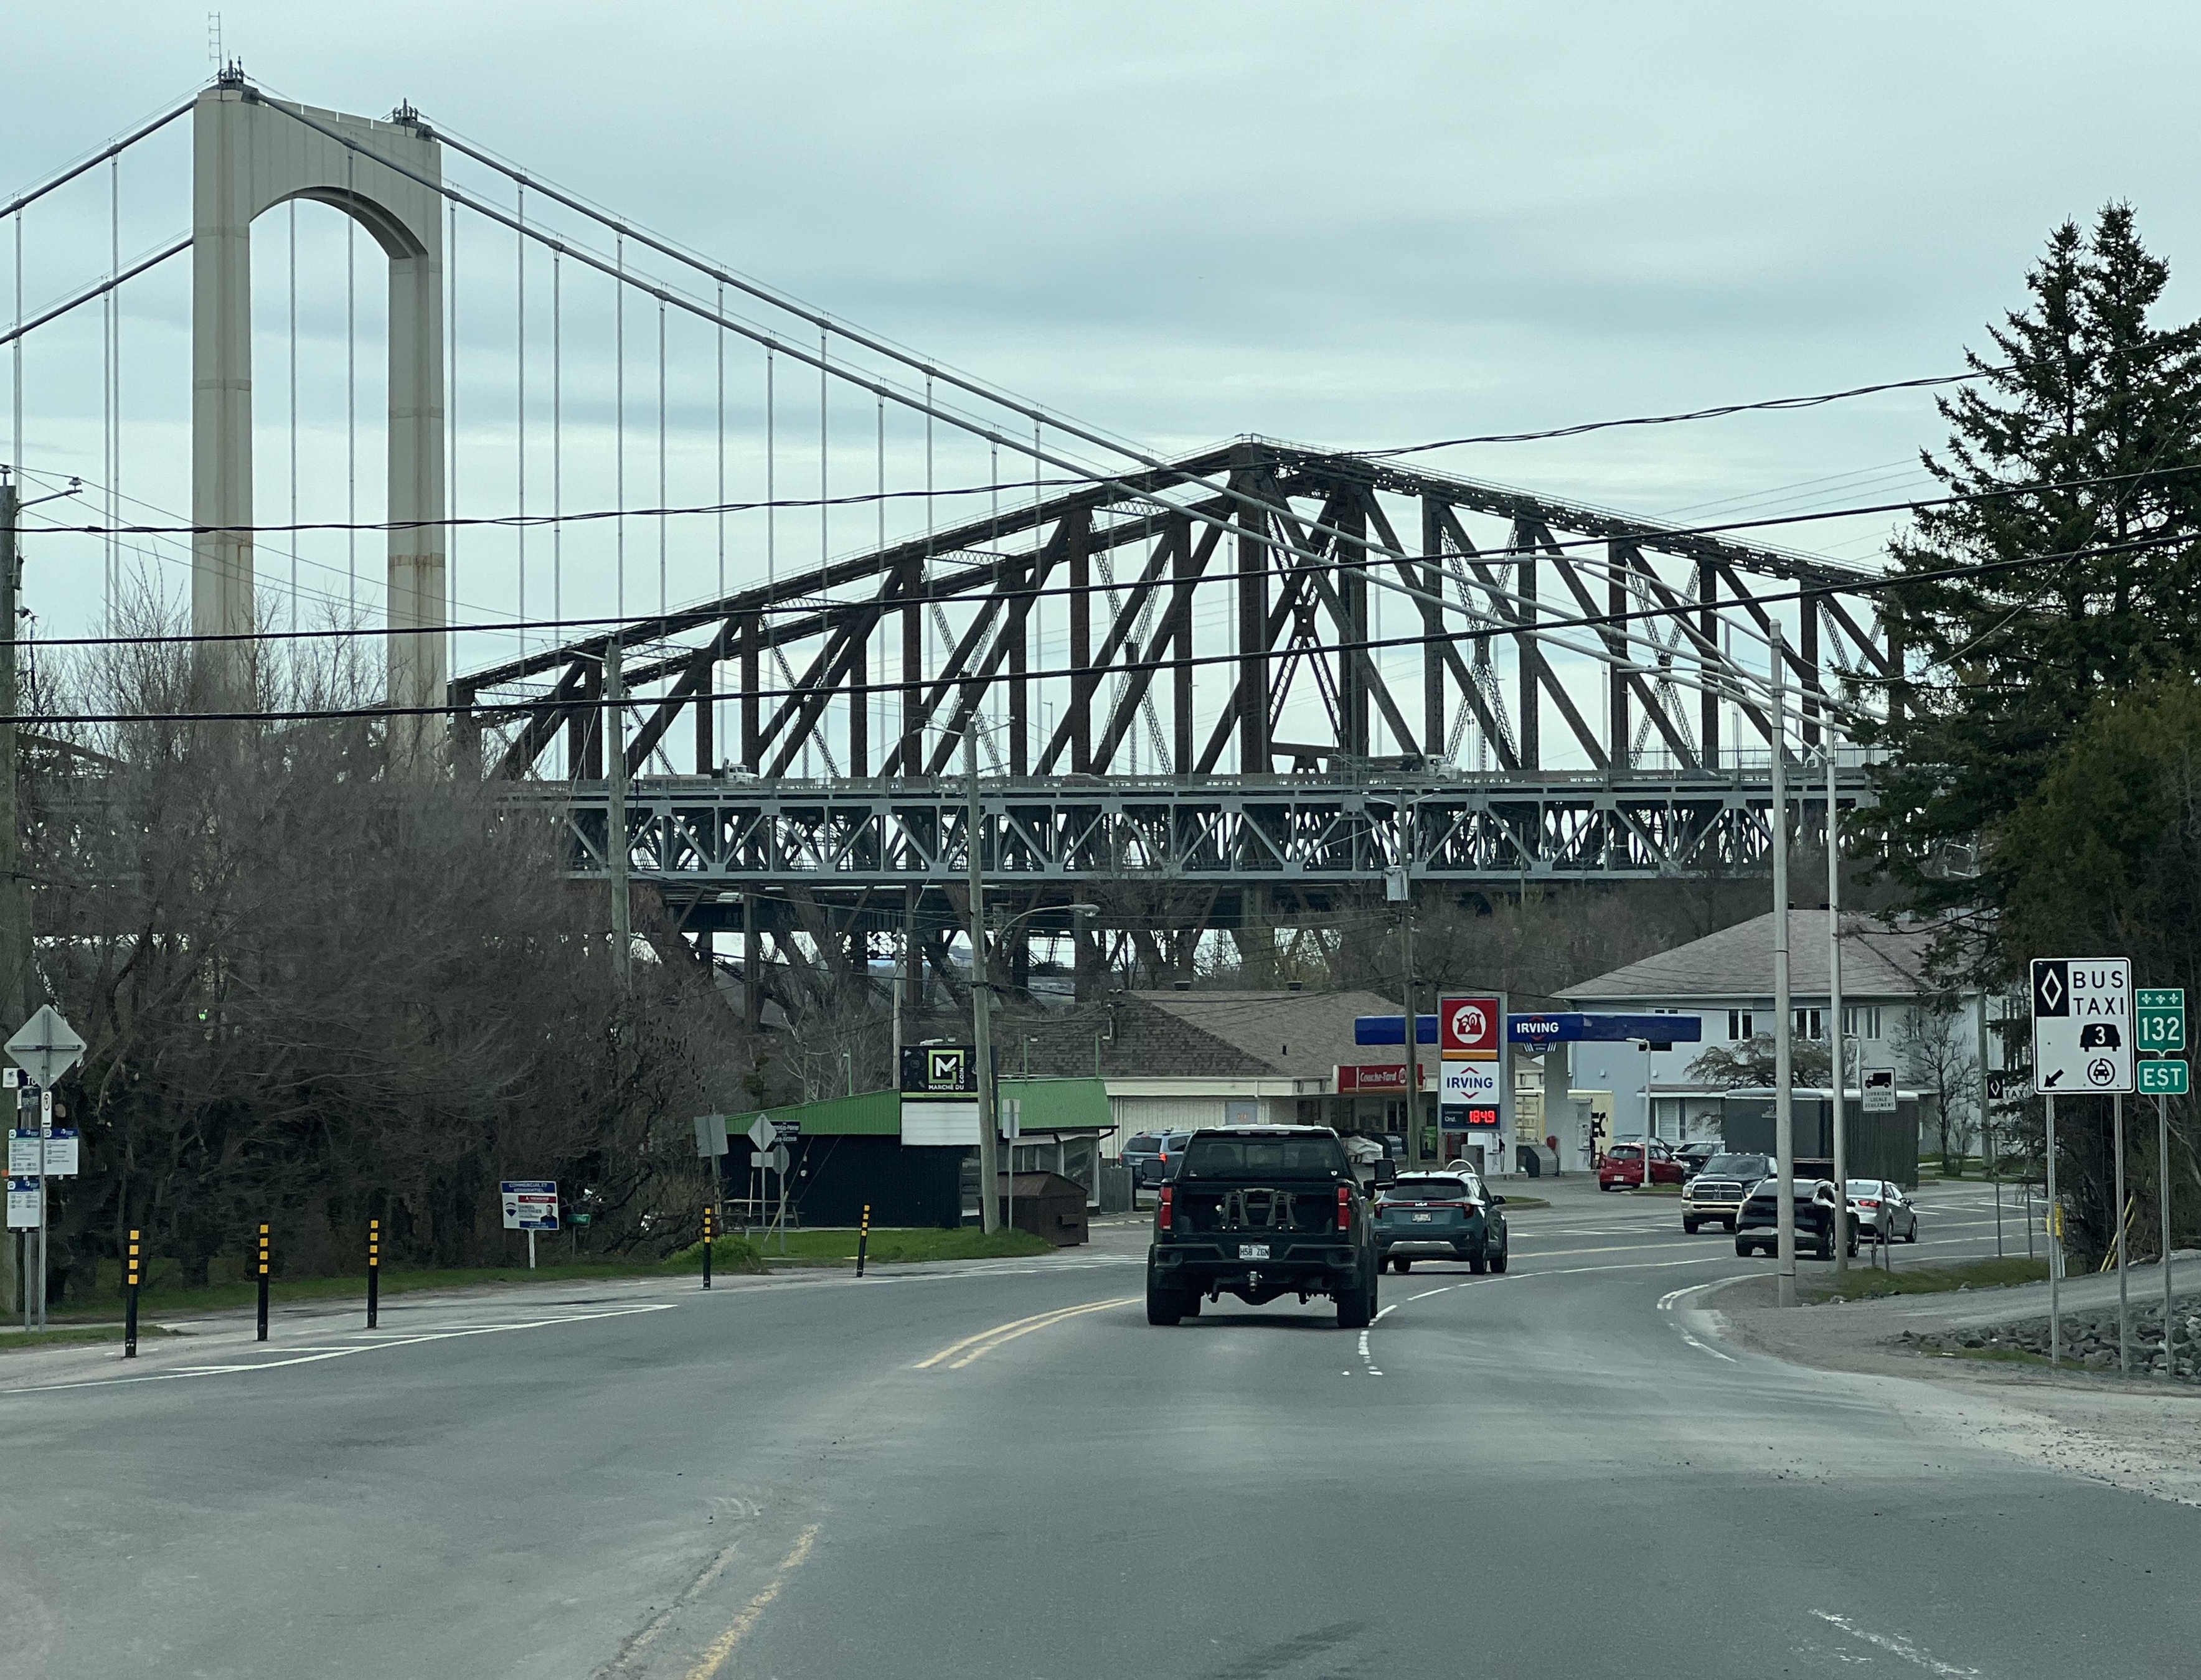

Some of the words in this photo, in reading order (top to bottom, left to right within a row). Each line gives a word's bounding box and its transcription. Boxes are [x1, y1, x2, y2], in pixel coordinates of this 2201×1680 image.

[2073, 970, 2124, 988] BUS
[2073, 997, 2124, 1016] TAXI
[1516, 1022, 1560, 1033] IRVING
[2095, 1026, 2106, 1045] 3
[2142, 1016, 2180, 1041] 132
[1360, 1071, 1397, 1082] Couche-Tard
[1446, 1077, 1494, 1089] IRVING
[2143, 1068, 2182, 1087] EST
